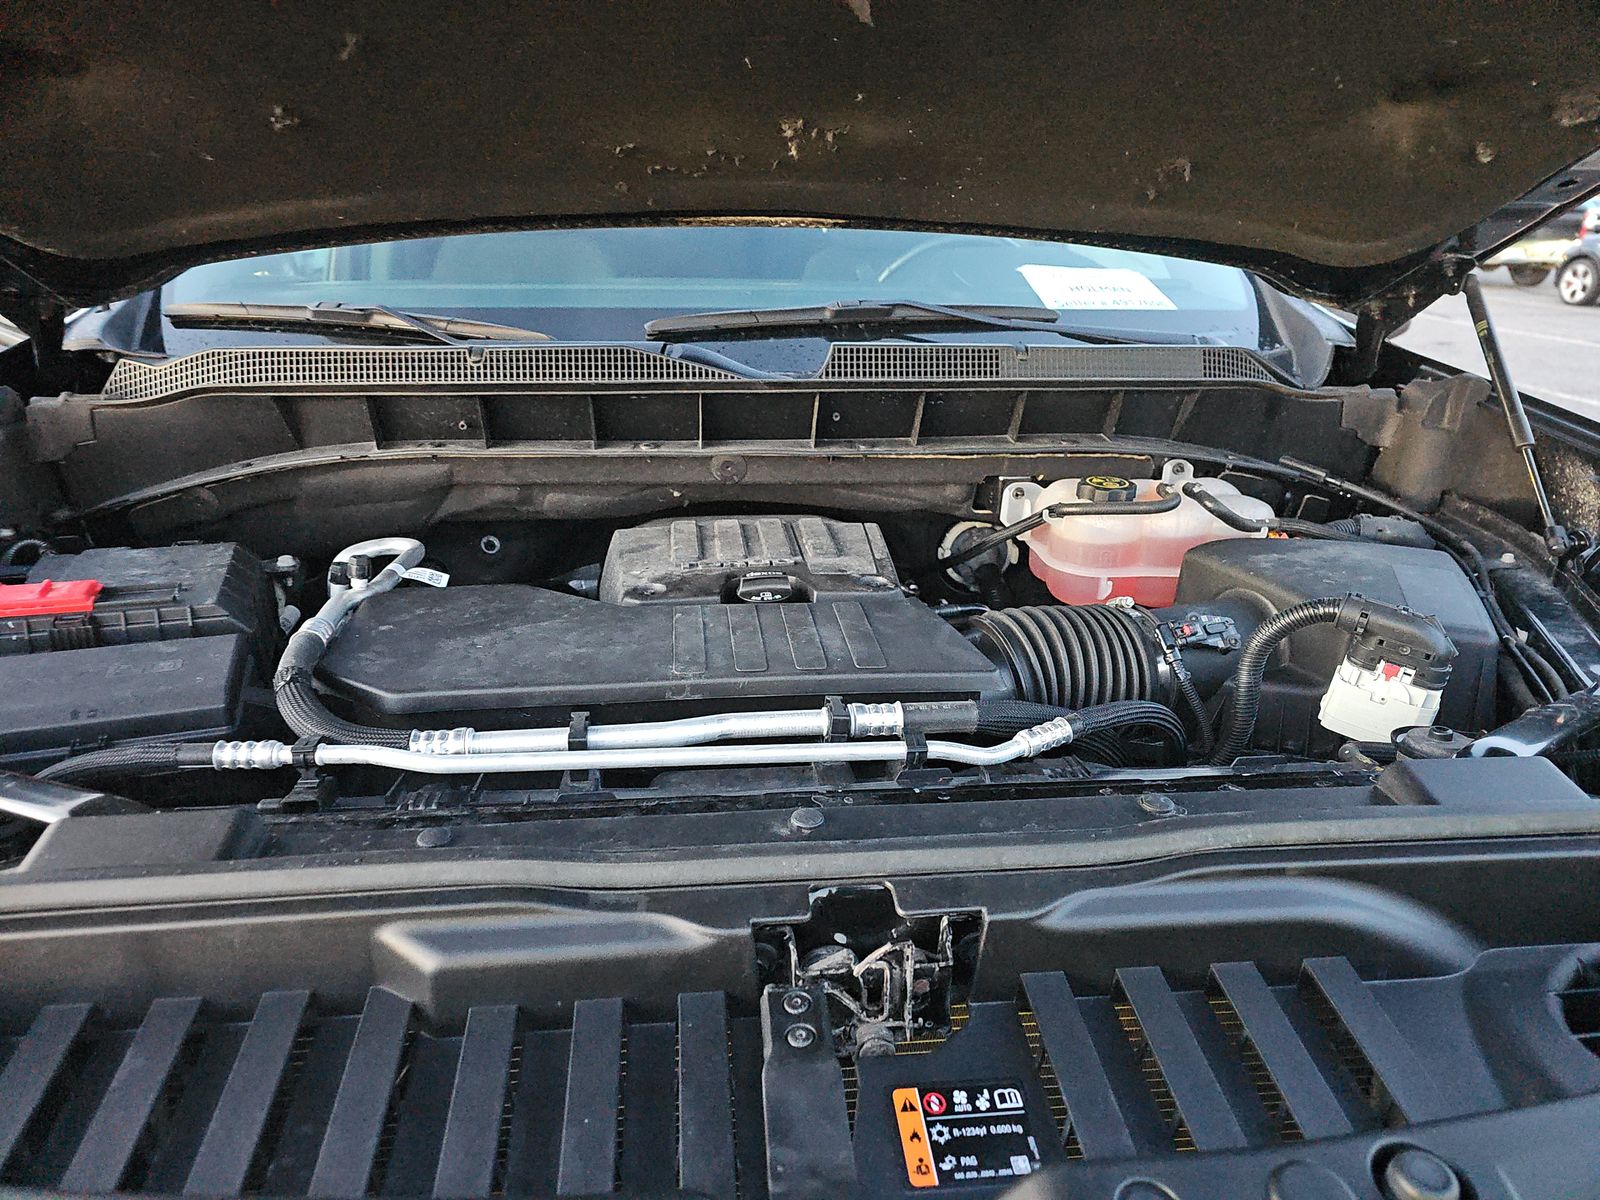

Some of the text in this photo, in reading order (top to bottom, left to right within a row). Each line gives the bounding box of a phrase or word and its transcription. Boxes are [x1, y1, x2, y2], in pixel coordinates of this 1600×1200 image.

[1069, 285, 1133, 294] HOLMAN
[954, 1103, 972, 1112] AUTO
[960, 1155, 978, 1167] PAG
